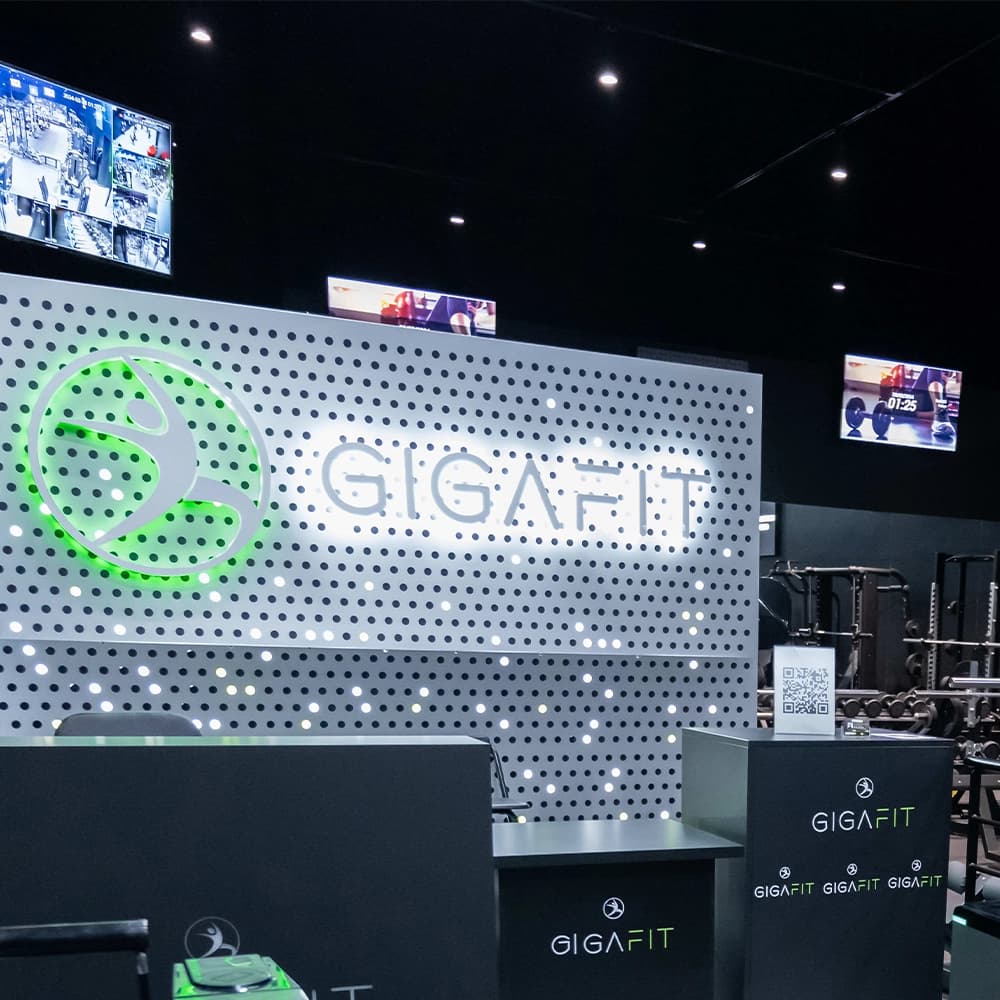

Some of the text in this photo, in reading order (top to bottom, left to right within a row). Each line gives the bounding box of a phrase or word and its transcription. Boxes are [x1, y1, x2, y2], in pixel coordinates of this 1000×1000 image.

[888, 397, 918, 412] 01:25
[322, 442, 712, 538] GIGAFIT
[811, 806, 916, 833] GIGAFIT
[754, 882, 815, 898] GIGAFIT
[823, 878, 881, 894] GIGAFIT
[888, 875, 942, 889] GIGAFIT
[551, 927, 675, 955] GIGAFIT
